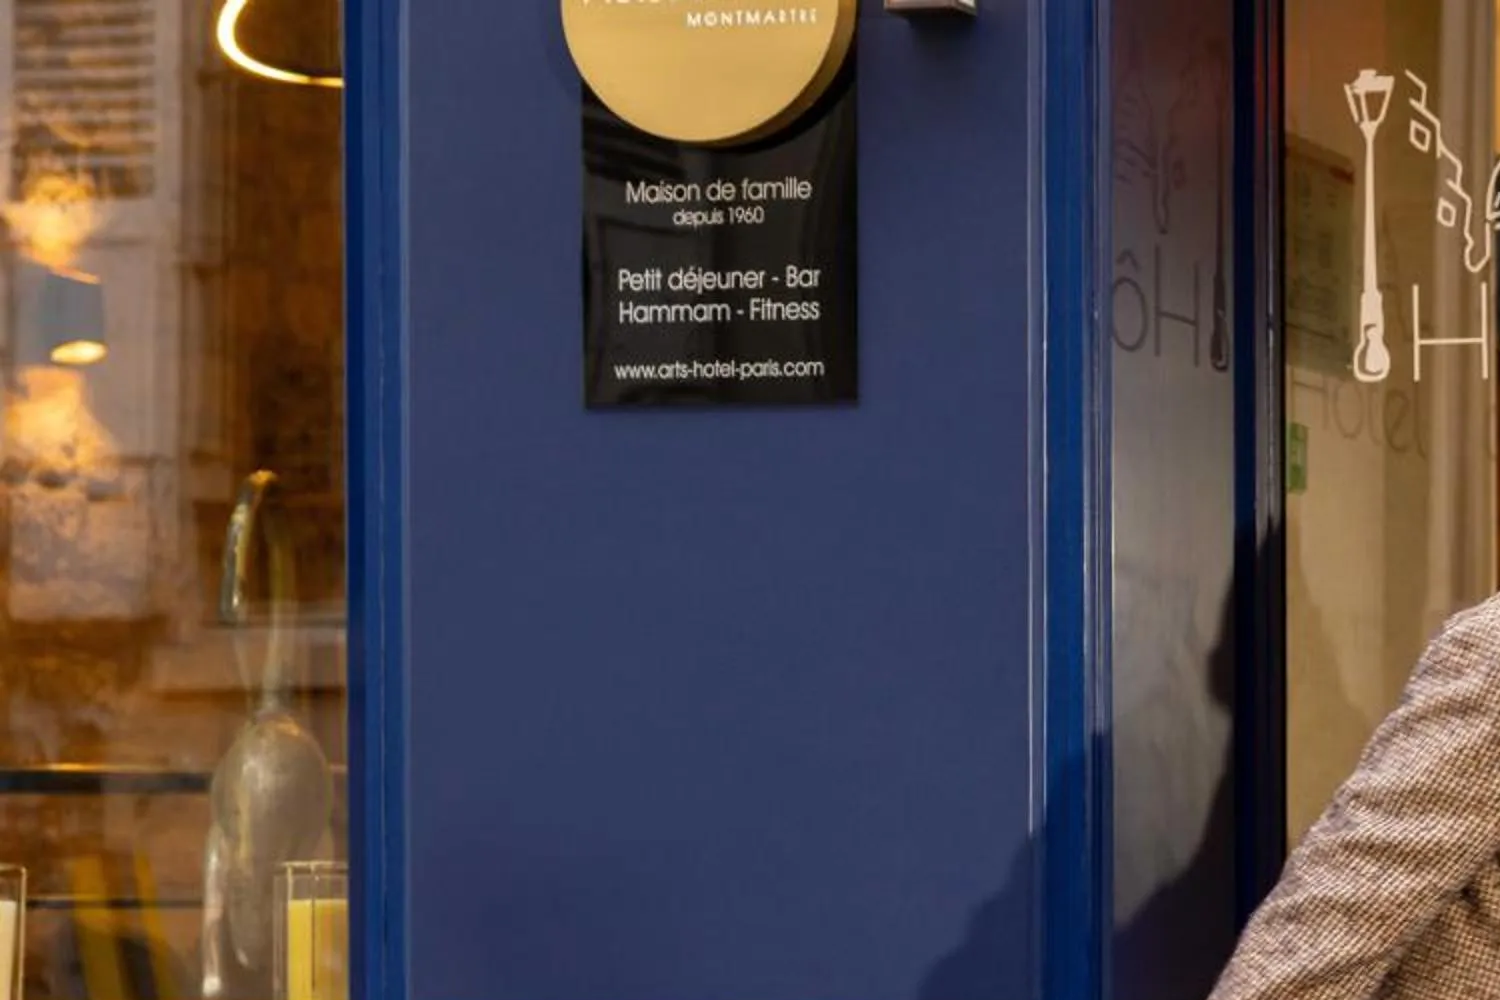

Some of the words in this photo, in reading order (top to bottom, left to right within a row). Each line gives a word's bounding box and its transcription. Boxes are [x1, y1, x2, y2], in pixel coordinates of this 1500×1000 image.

[686, 8, 818, 27] MONTMARTRE
[625, 180, 700, 204] Maison
[705, 179, 736, 201] de
[741, 176, 813, 200] famille
[672, 208, 724, 227] depuis
[728, 206, 765, 224] 1960
[618, 268, 662, 292] Petit
[667, 265, 766, 295] déjeuner
[785, 265, 821, 288] Bar
[618, 301, 731, 324] Hammam
[750, 298, 821, 320] Fitness
[614, 359, 825, 380] www.arts-hotel-paris.com
